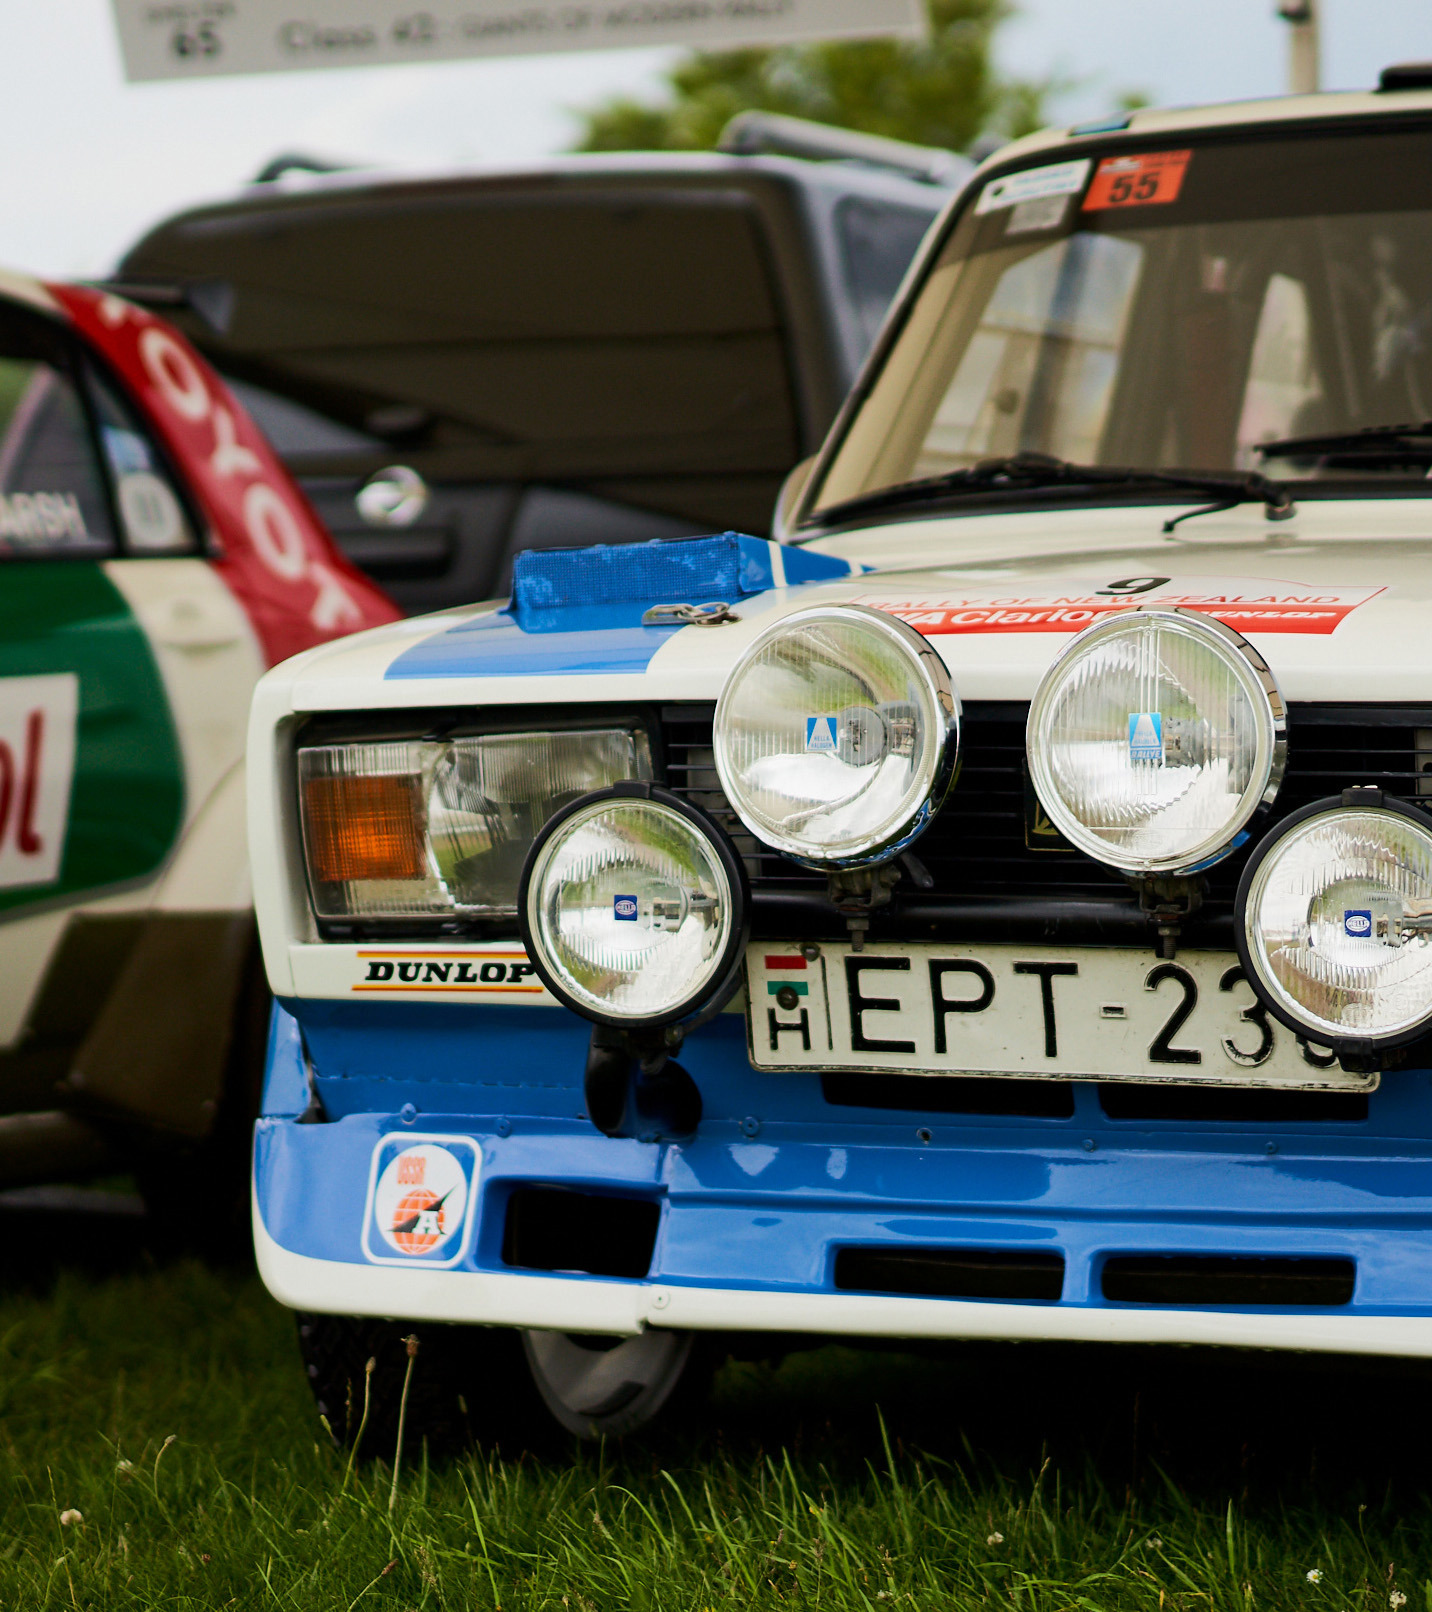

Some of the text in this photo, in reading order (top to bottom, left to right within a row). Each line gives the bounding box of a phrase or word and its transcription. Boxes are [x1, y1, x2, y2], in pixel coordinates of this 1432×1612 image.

[1108, 172, 1160, 203] 55
[1095, 577, 1171, 595] 9
[991, 596, 1047, 607] OF
[1051, 595, 1149, 605] NEW
[1166, 595, 1341, 604] ZEALAND
[365, 962, 537, 982] DUNLOP
[845, 955, 1340, 1068] EPT-23
[767, 1007, 811, 1051] H
